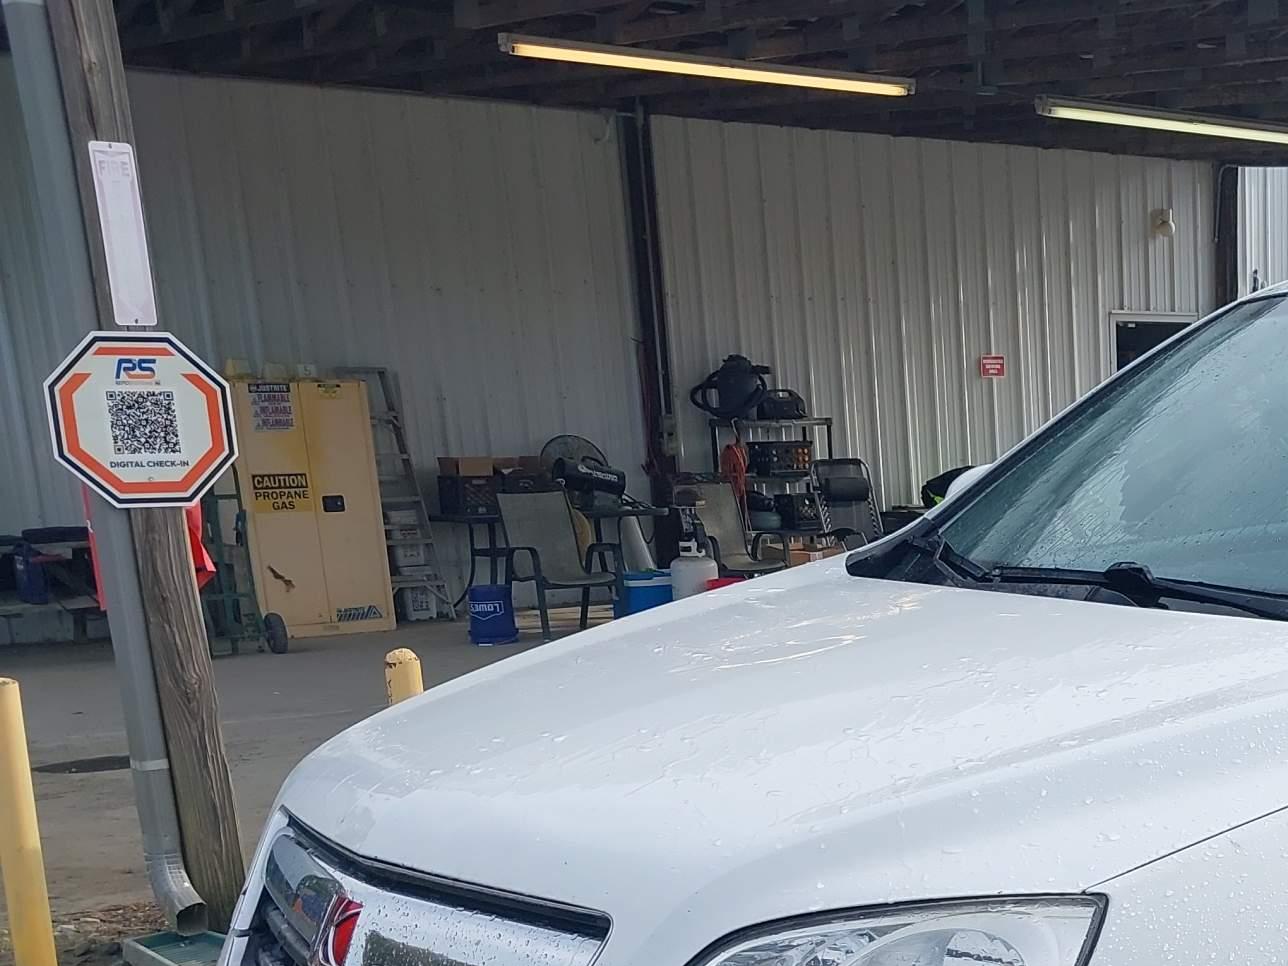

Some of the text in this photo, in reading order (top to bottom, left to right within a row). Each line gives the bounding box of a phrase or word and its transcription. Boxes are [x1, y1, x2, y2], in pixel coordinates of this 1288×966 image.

[98, 160, 130, 176] FIRE
[146, 460, 189, 468] CHECK-IN
[254, 475, 307, 488] CAUTION
[255, 490, 310, 501] PROPANE
[272, 501, 296, 511] GAS
